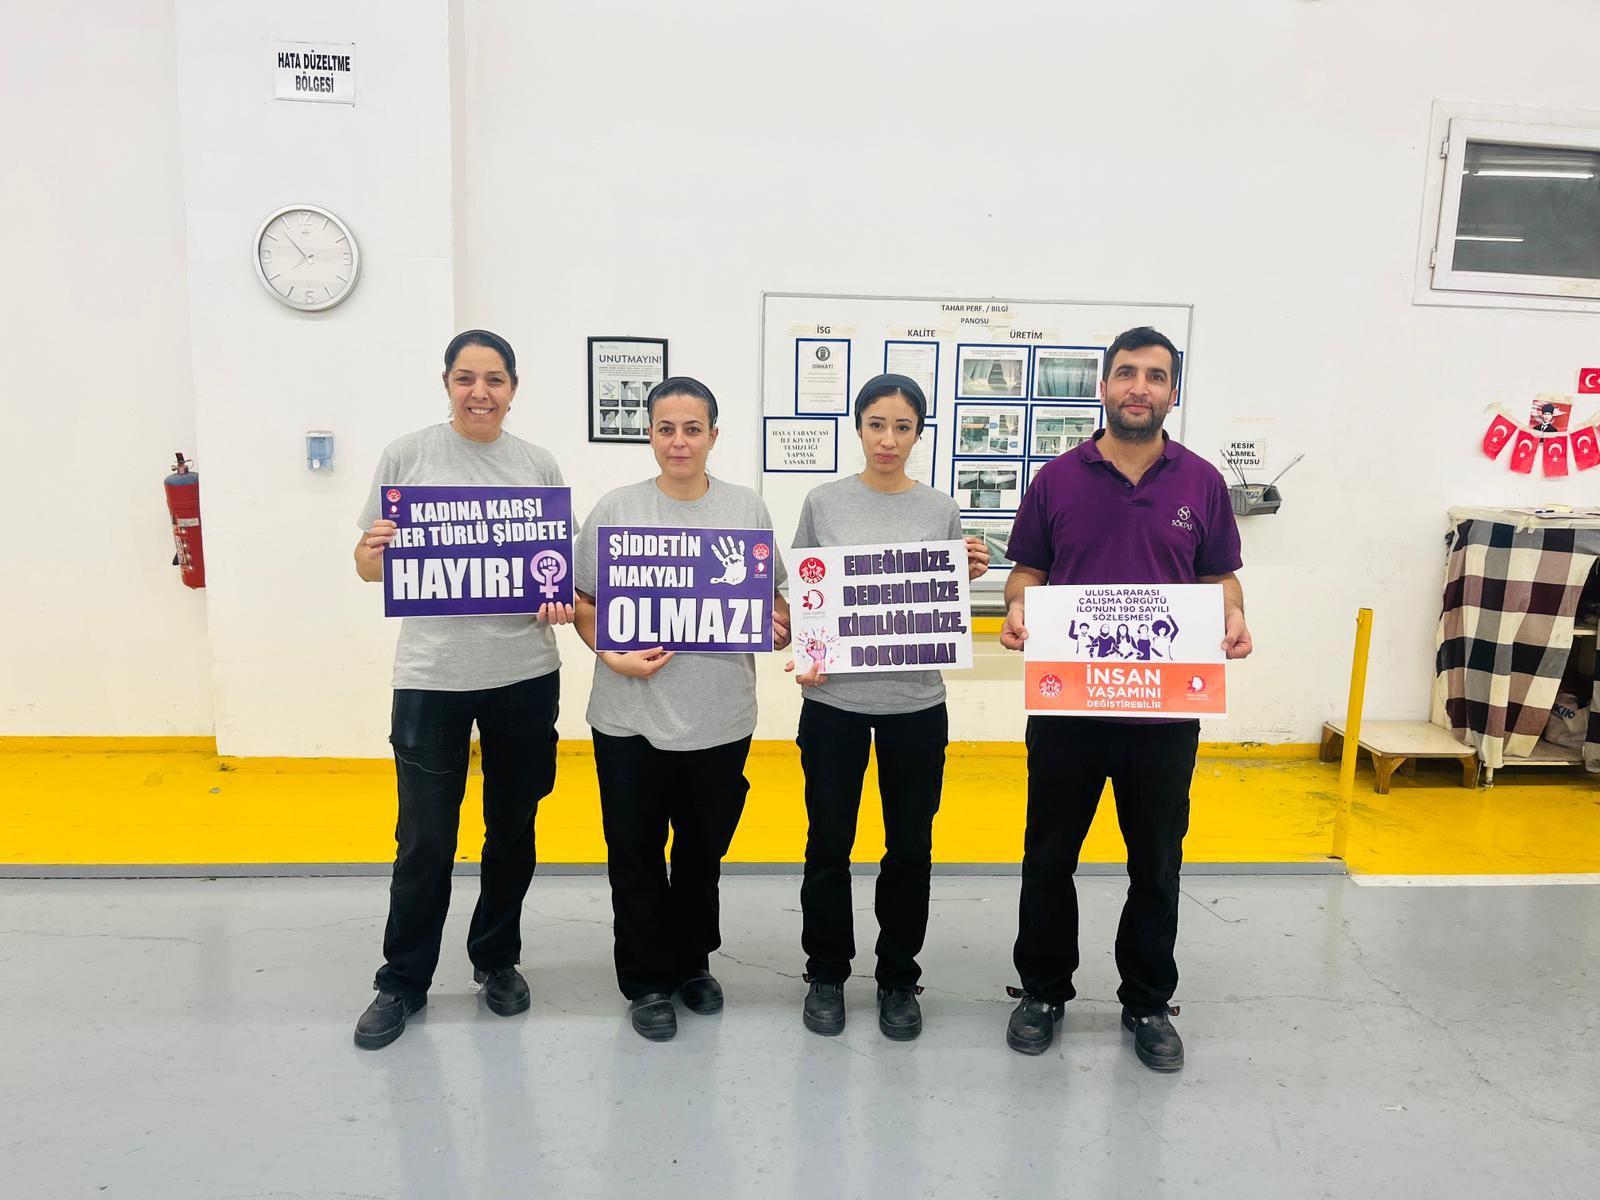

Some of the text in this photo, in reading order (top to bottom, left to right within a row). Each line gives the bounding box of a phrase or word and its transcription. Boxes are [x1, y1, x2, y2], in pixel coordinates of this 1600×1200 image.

[278, 50, 351, 72] HATA DÜZELTME
[295, 71, 334, 93] BÖLGESİ
[941, 304, 965, 312] TAHAR
[991, 305, 1009, 313] BİLGİ
[816, 324, 831, 334] İSG
[960, 317, 989, 325] PANOSU
[907, 328, 936, 338] KALİTE
[1009, 329, 1043, 340] ÜRETİM
[599, 354, 662, 365] UNUTMAYIN!
[410, 498, 543, 523] KADINA KARŞI
[428, 521, 489, 546] TÜRLÜ
[492, 520, 568, 547] ŞİDDETE
[609, 530, 701, 560] ŞİDDETİN
[843, 548, 956, 576] EMEĞİMİZE,
[391, 557, 525, 600] HAYIR!
[609, 565, 694, 588] MAKYAJI
[842, 578, 960, 607] BEDENİMİZE
[1078, 595, 1167, 605] ÇALIŞMA ÖRGÜTÜ
[608, 596, 764, 644] OLMAZ!
[1076, 605, 1169, 613] ILO'NUN 190 SAYILI
[1092, 613, 1153, 622] SÖZLEŞMESİ
[838, 608, 968, 637] KİMLİĞİMİZE,
[850, 642, 957, 667] DOKUNMA!
[1086, 664, 1161, 686] İNSAN
[1086, 686, 1161, 699] YAŞAMINI
[1087, 699, 1161, 709] DEĞİŞTİREBİLİR
